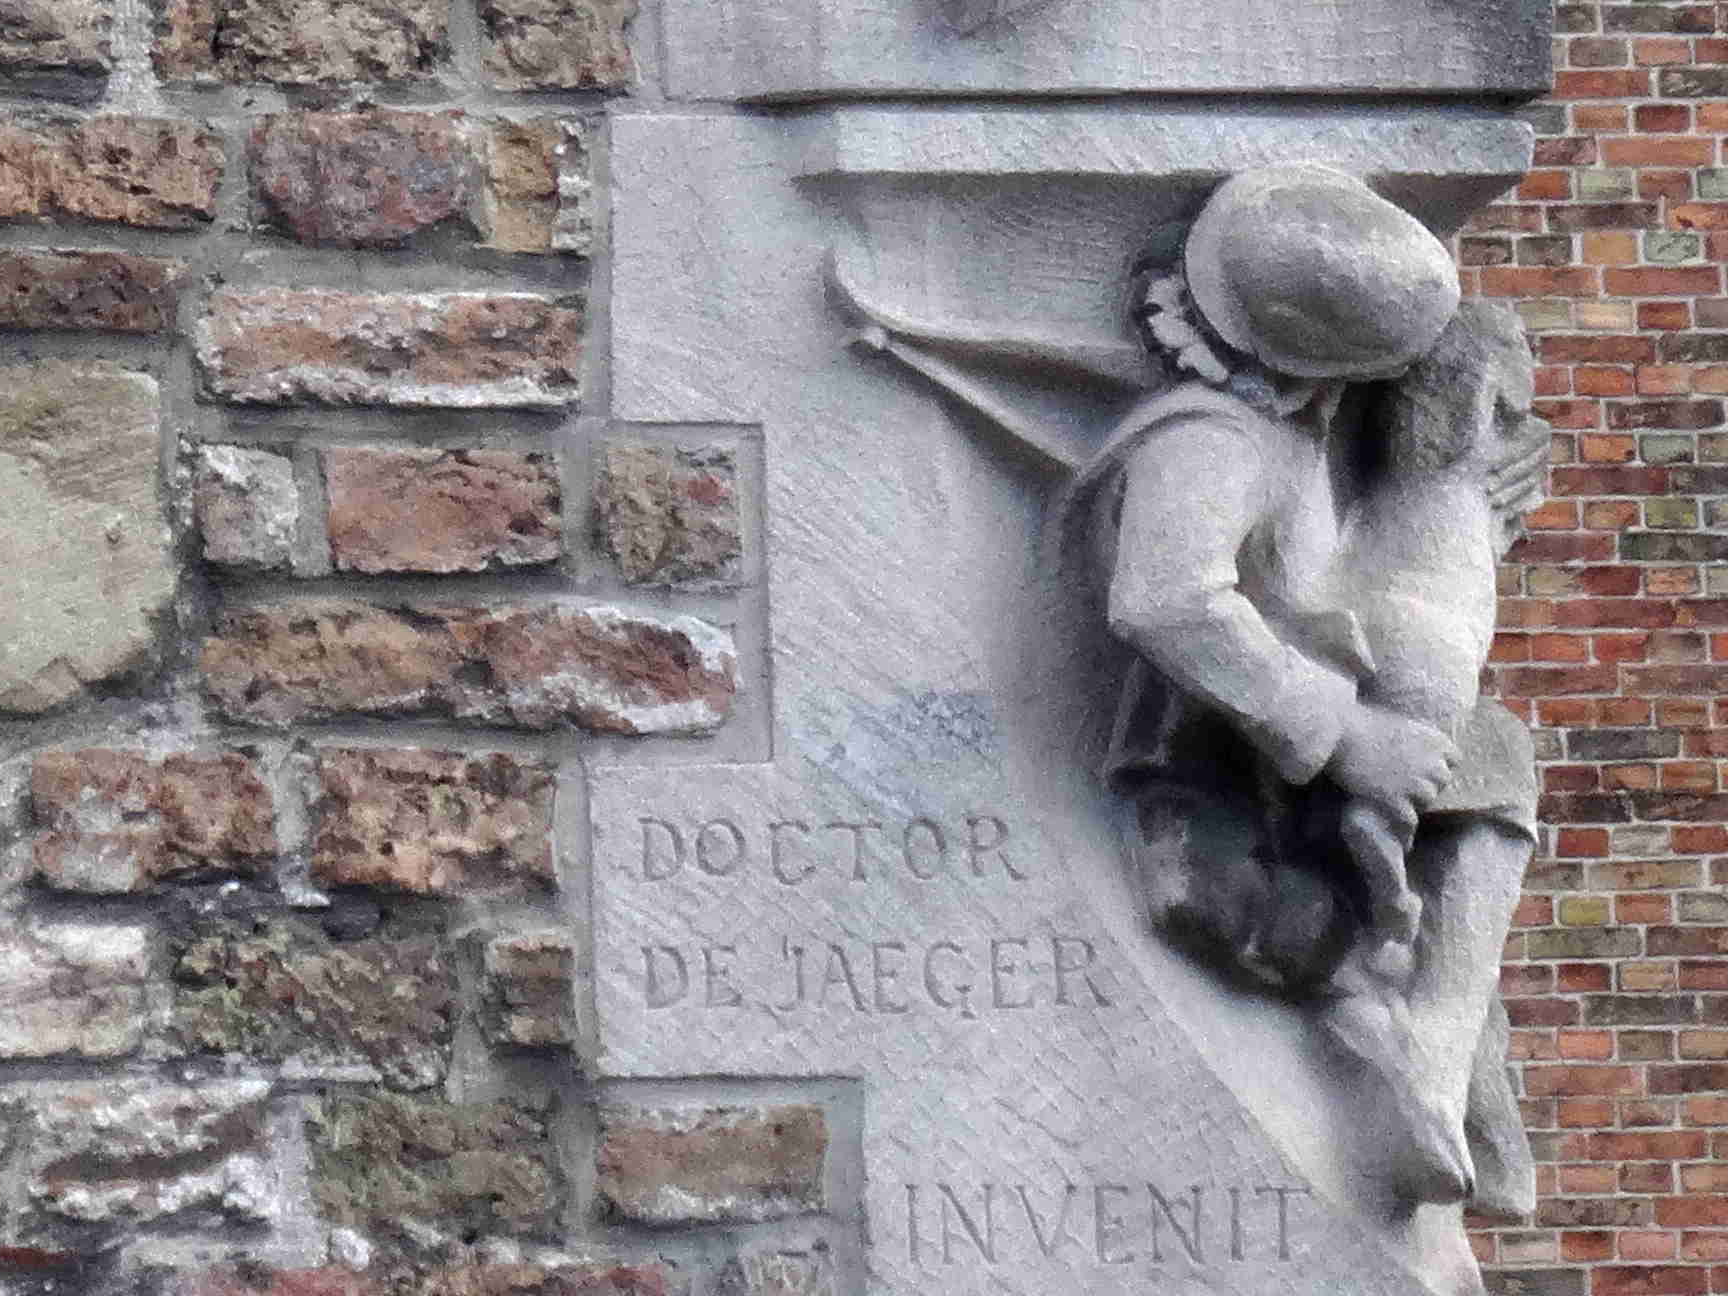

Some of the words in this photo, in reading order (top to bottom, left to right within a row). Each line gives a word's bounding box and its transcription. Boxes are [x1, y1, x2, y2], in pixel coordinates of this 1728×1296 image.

[636, 814, 1029, 886] DOCTOR
[640, 942, 744, 1010] DE
[772, 934, 1114, 1020] JAEGER
[904, 1182, 1312, 1266] INVENIT
